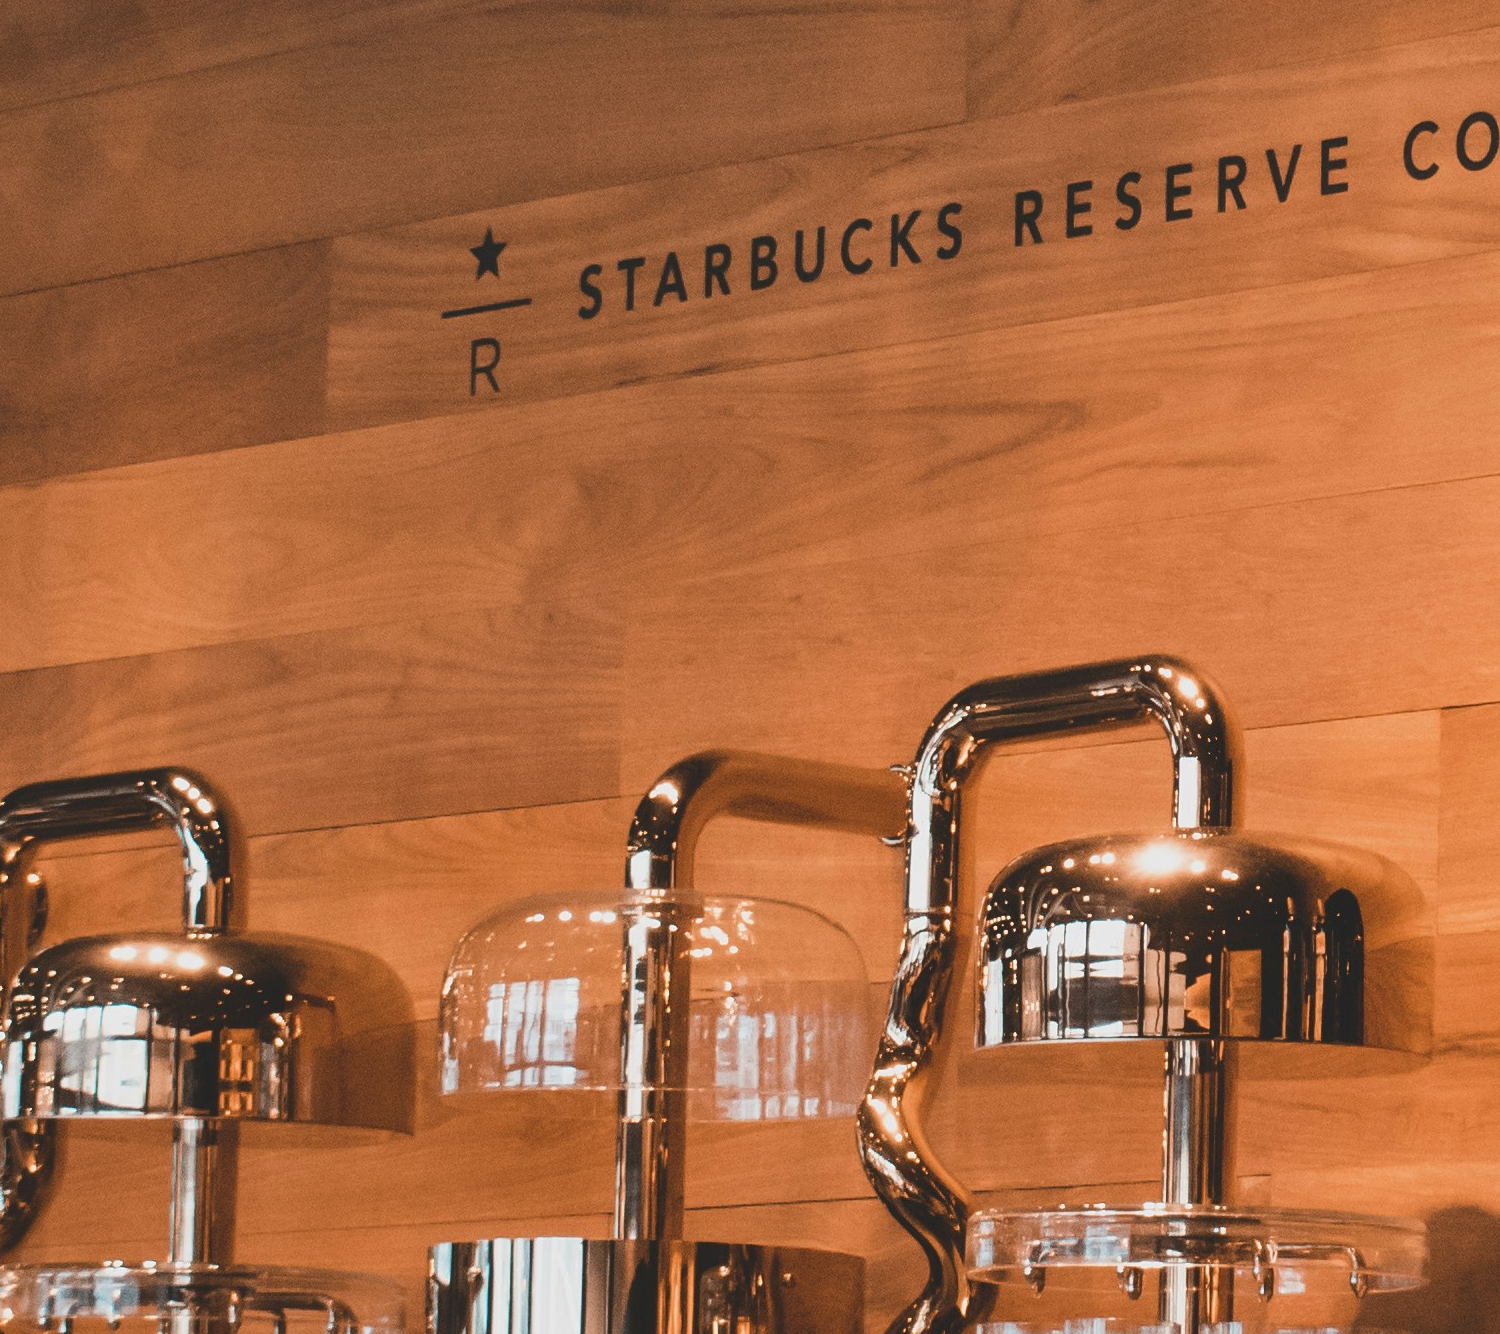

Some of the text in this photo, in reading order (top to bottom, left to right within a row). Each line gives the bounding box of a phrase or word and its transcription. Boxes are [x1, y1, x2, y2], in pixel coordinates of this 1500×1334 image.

[578, 201, 963, 320] STARBUCKS
[1013, 135, 1350, 247] RESERVE
[469, 336, 502, 397] R
